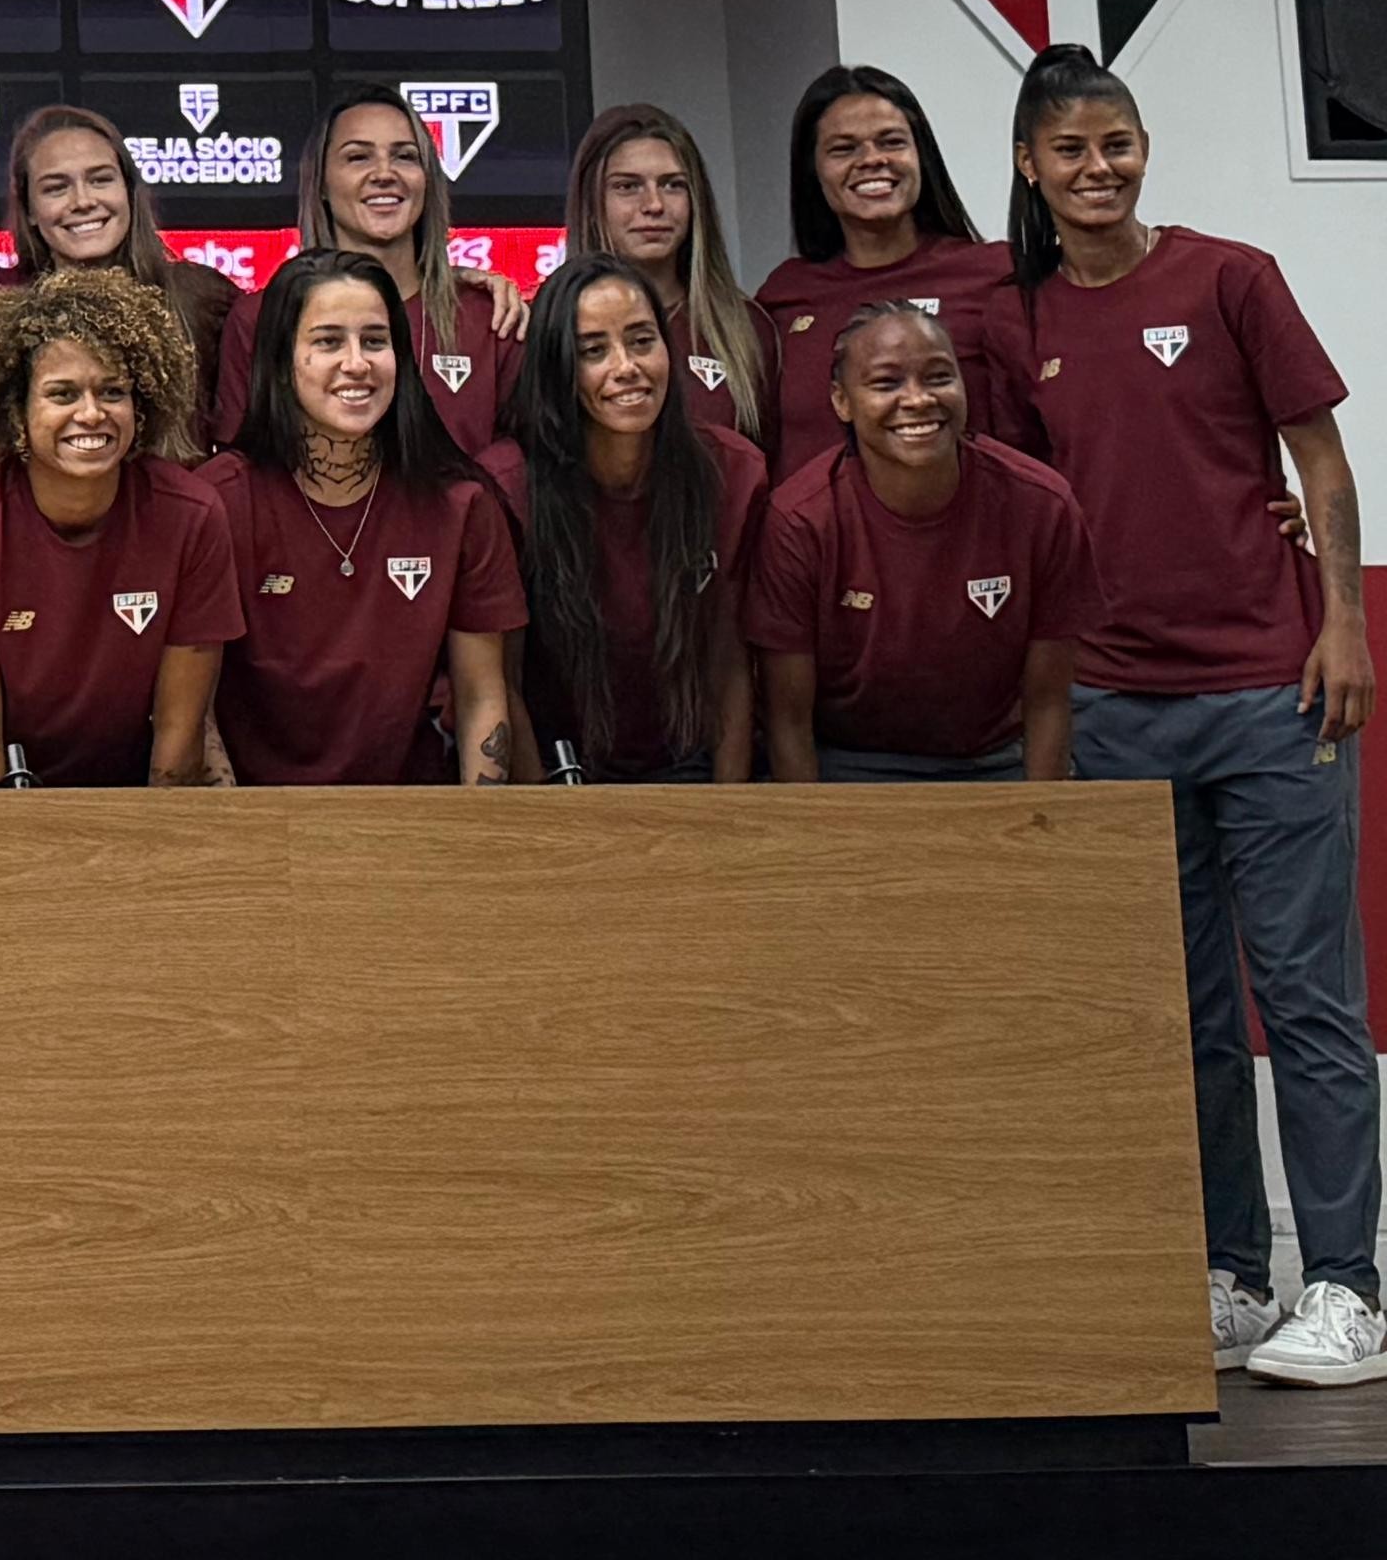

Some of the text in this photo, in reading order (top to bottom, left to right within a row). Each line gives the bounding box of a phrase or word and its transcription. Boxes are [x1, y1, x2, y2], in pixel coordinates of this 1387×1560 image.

[410, 91, 490, 112] SPFC
[194, 132, 280, 160] SÓCIO
[135, 159, 280, 183] ORCEDOR!
